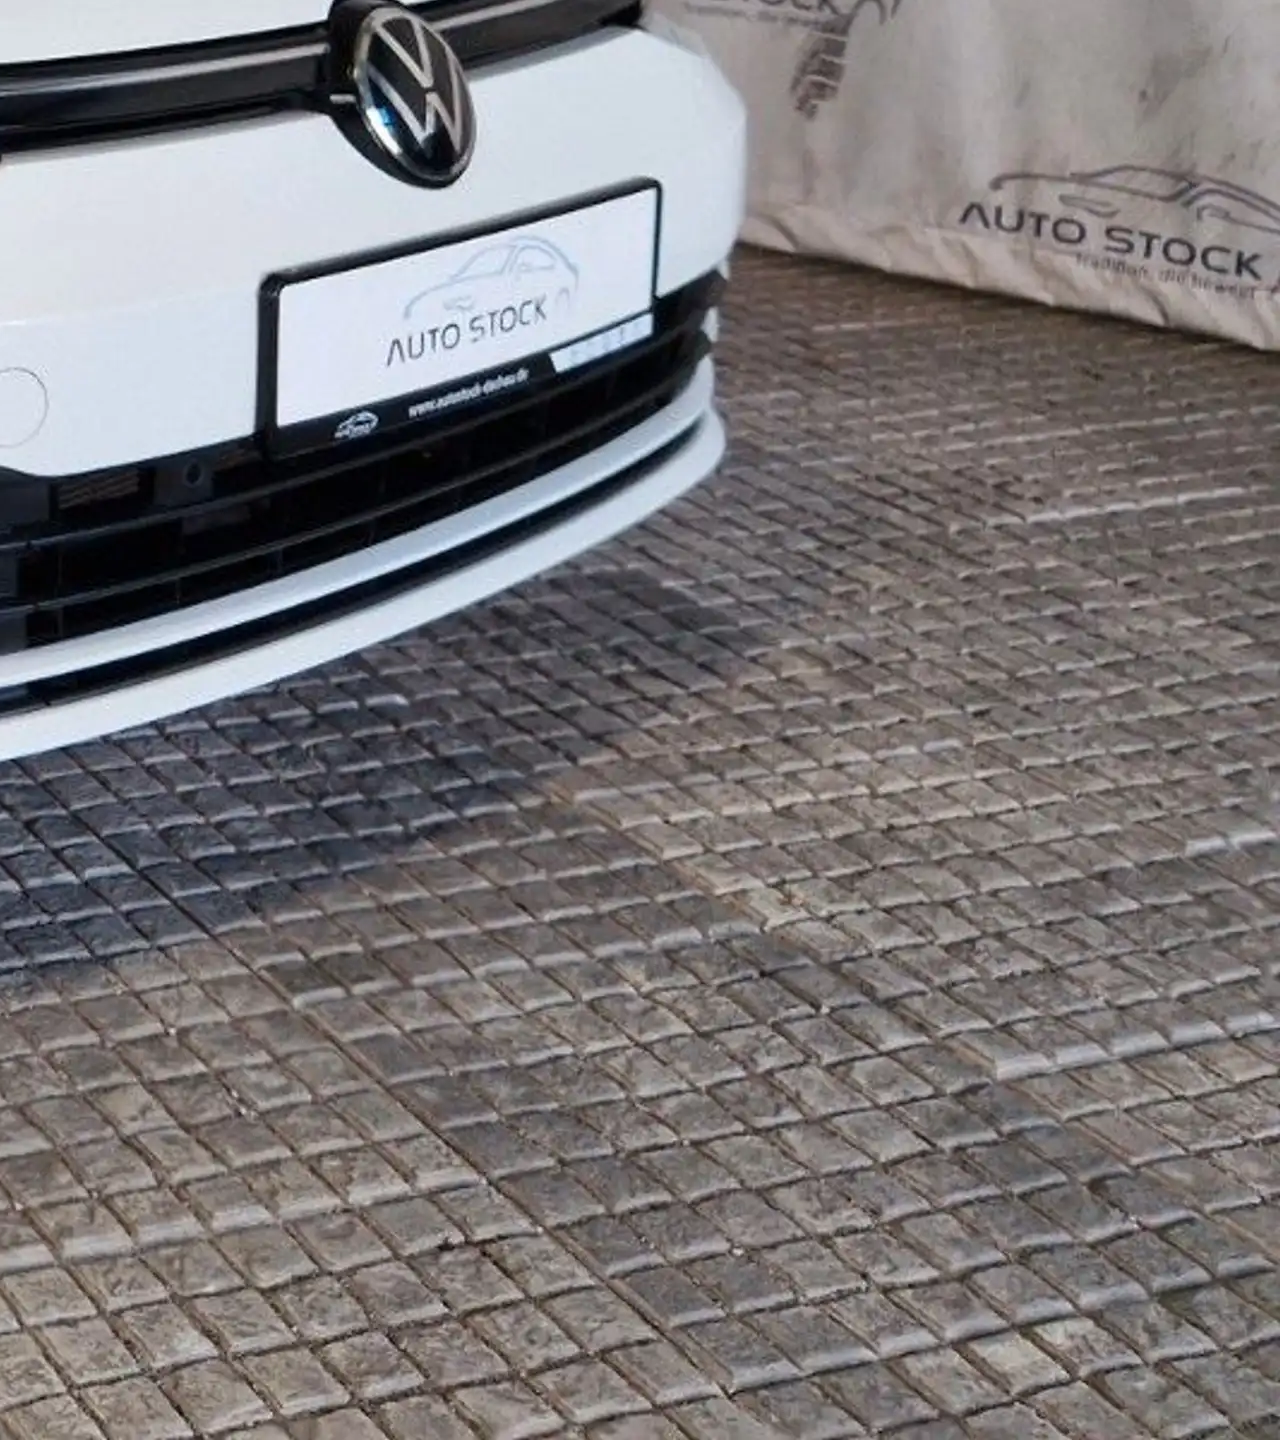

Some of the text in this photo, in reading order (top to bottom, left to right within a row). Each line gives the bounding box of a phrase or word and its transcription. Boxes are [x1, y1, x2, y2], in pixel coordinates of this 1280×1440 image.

[959, 201, 1262, 281] AUTO STOCK
[386, 291, 548, 367] AUTO STOCK
